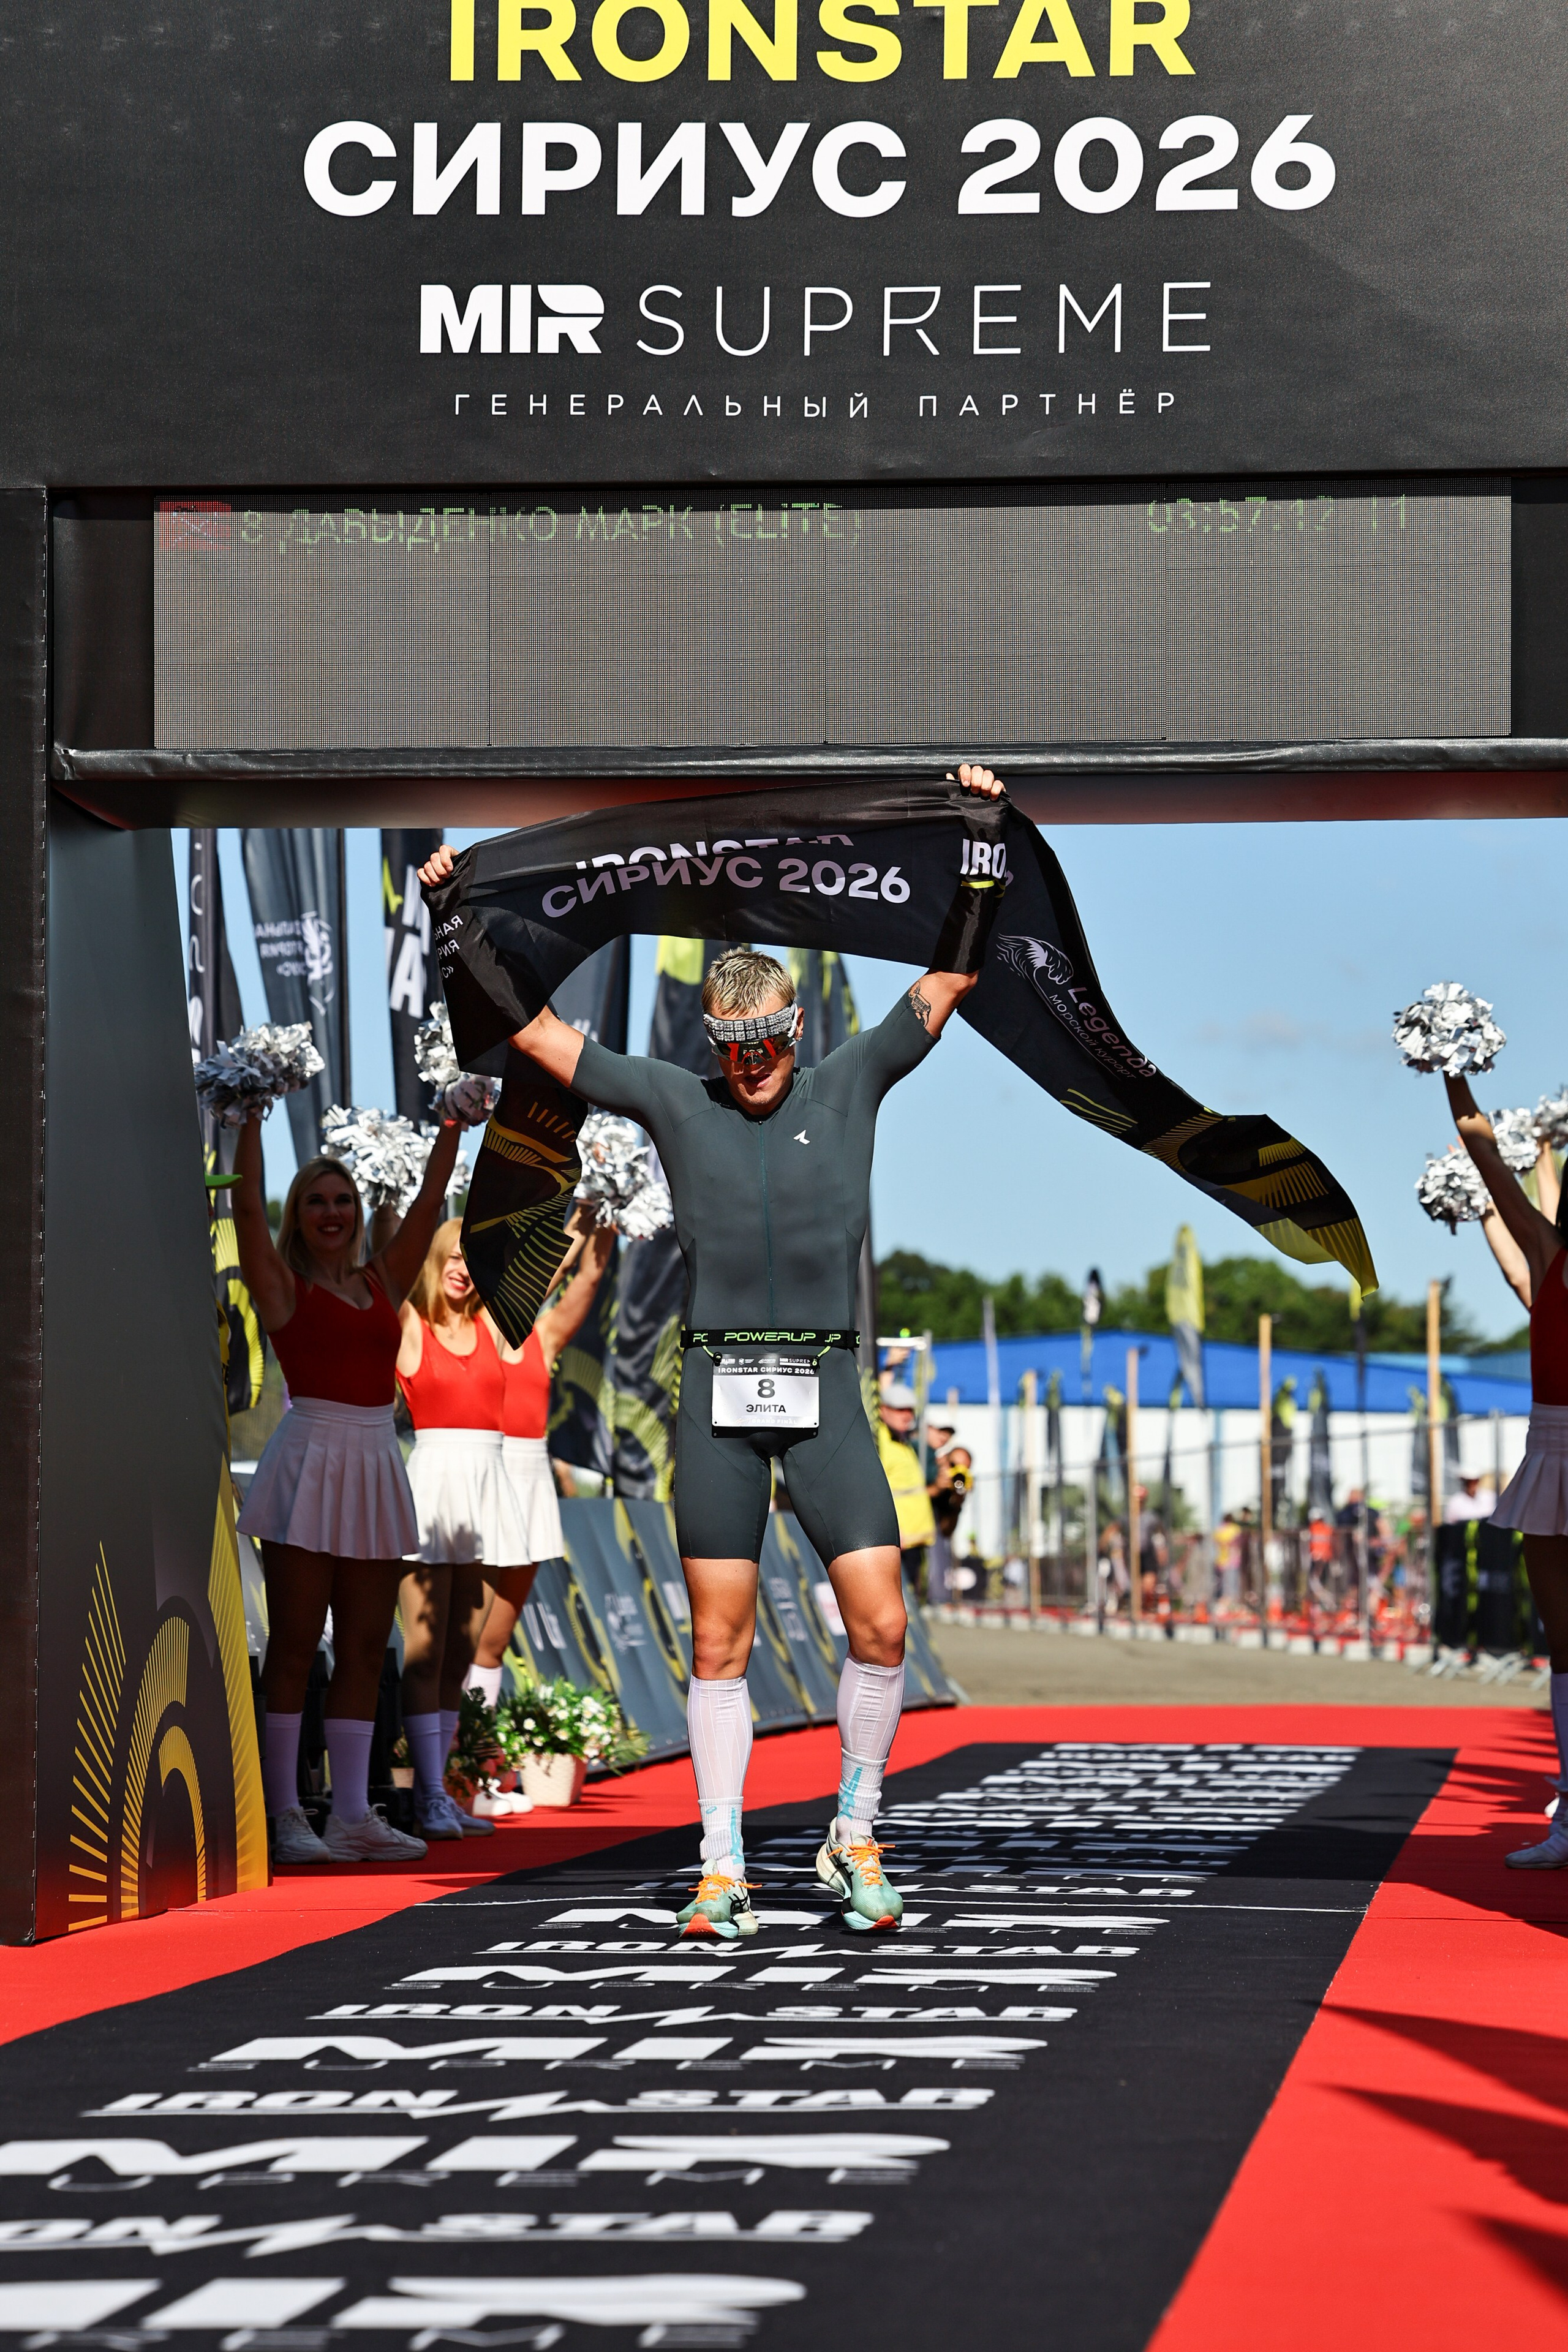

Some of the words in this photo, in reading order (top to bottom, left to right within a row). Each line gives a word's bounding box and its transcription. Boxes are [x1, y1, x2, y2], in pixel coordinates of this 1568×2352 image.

[450, 0, 1196, 83] IRONSTAR
[303, 120, 907, 219] СИРИУС
[957, 114, 1336, 216] 2026
[419, 284, 605, 355] MIR
[636, 281, 1212, 356] SUPREME
[454, 391, 869, 419] ГЕНЕРАЛЬНЫЙ
[919, 388, 1177, 418] ПАРТНЁР
[575, 504, 693, 540] МАРК
[959, 838, 1008, 880] IRO
[540, 854, 764, 918] СИРИУС
[778, 858, 911, 904] 2026
[437, 938, 461, 961] РИЯ
[1067, 987, 1157, 1078] Legenda
[724, 1332, 816, 1342] POWERUP
[757, 1378, 775, 1399] 8
[745, 1404, 786, 1414] ЭЛИТА
[964, 1885, 1196, 1896] STAR
[486, 1940, 747, 1952] IRON
[870, 1945, 1140, 1955] STAR
[400, 1965, 1117, 1985] MIR
[323, 2003, 620, 2017] IRON
[766, 2006, 1079, 2019] STAR
[210, 2035, 1048, 2061] MIR
[103, 2089, 459, 2110] IRON
[626, 2087, 996, 2106] STAR
[0, 2132, 951, 2176] MIR
